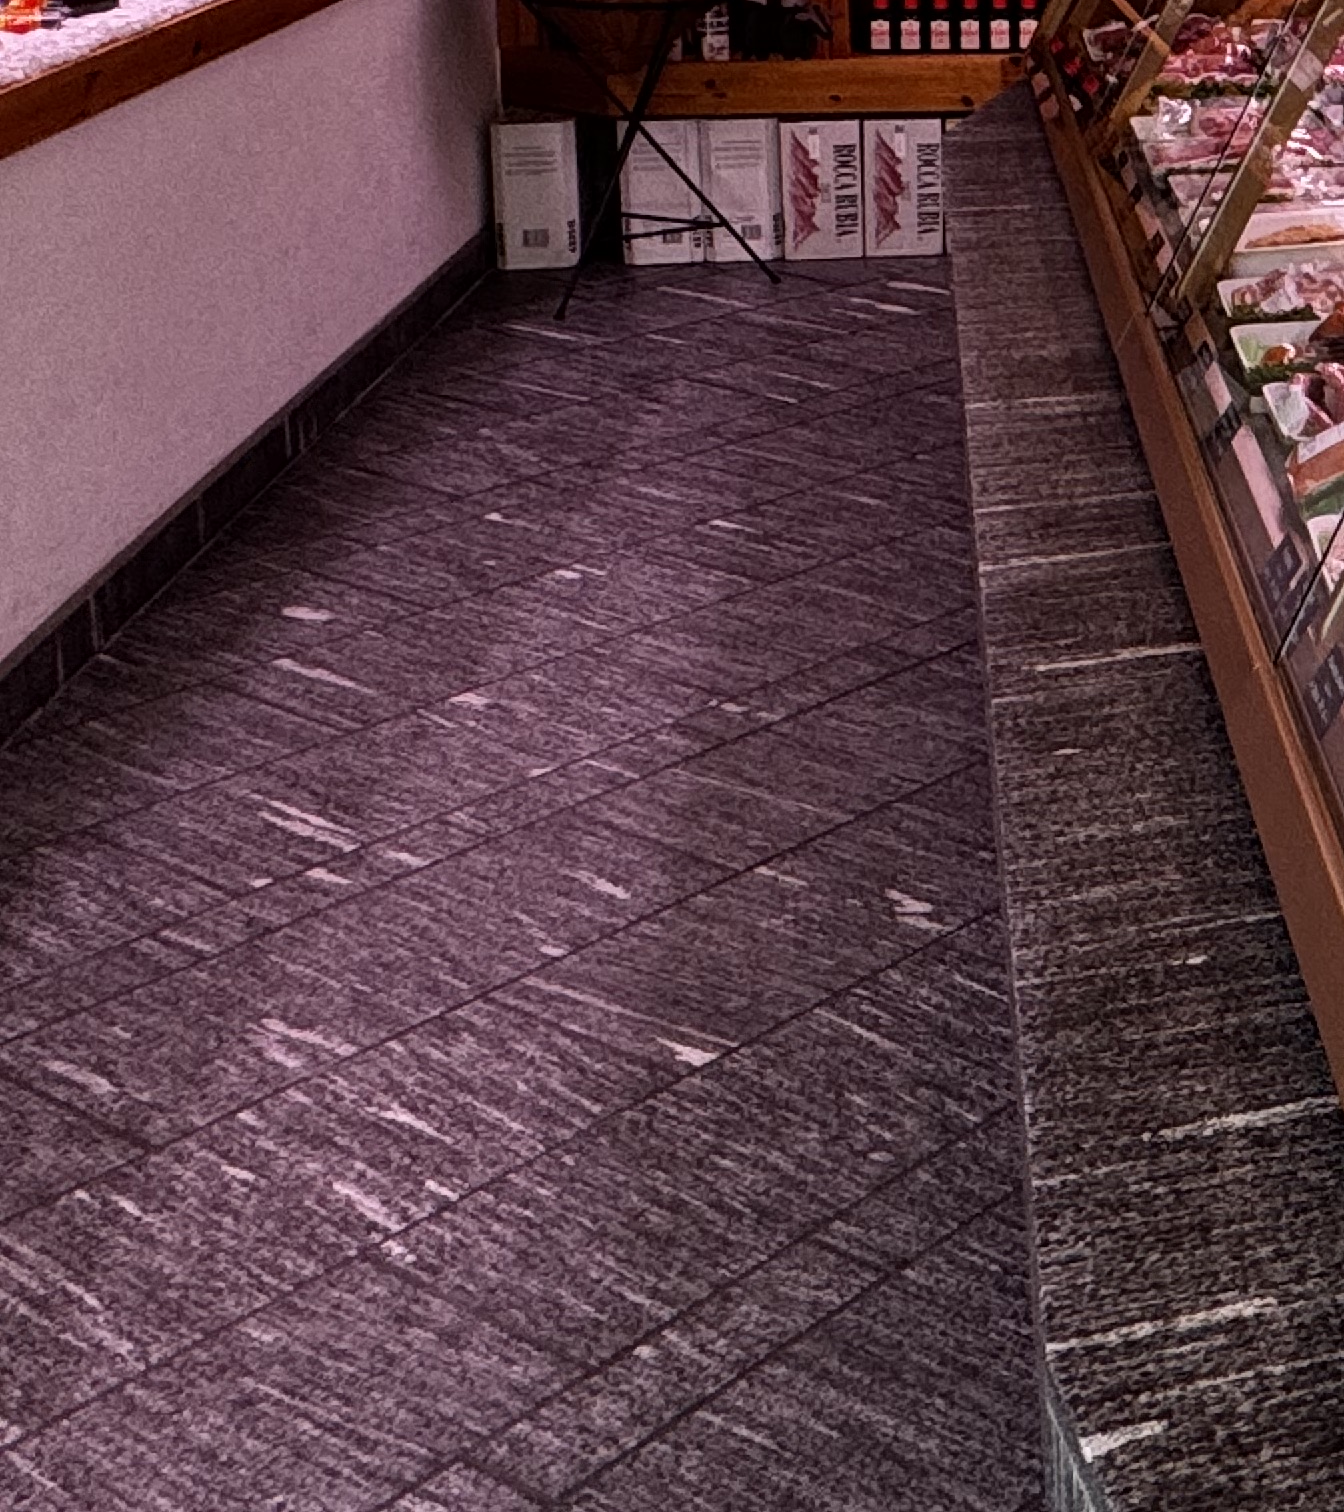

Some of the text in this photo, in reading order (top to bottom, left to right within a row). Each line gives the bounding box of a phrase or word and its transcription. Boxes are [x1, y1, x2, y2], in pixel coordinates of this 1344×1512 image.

[834, 143, 858, 238] ROCCA RUBIA
[916, 142, 940, 236] ROCCA RUBIA
